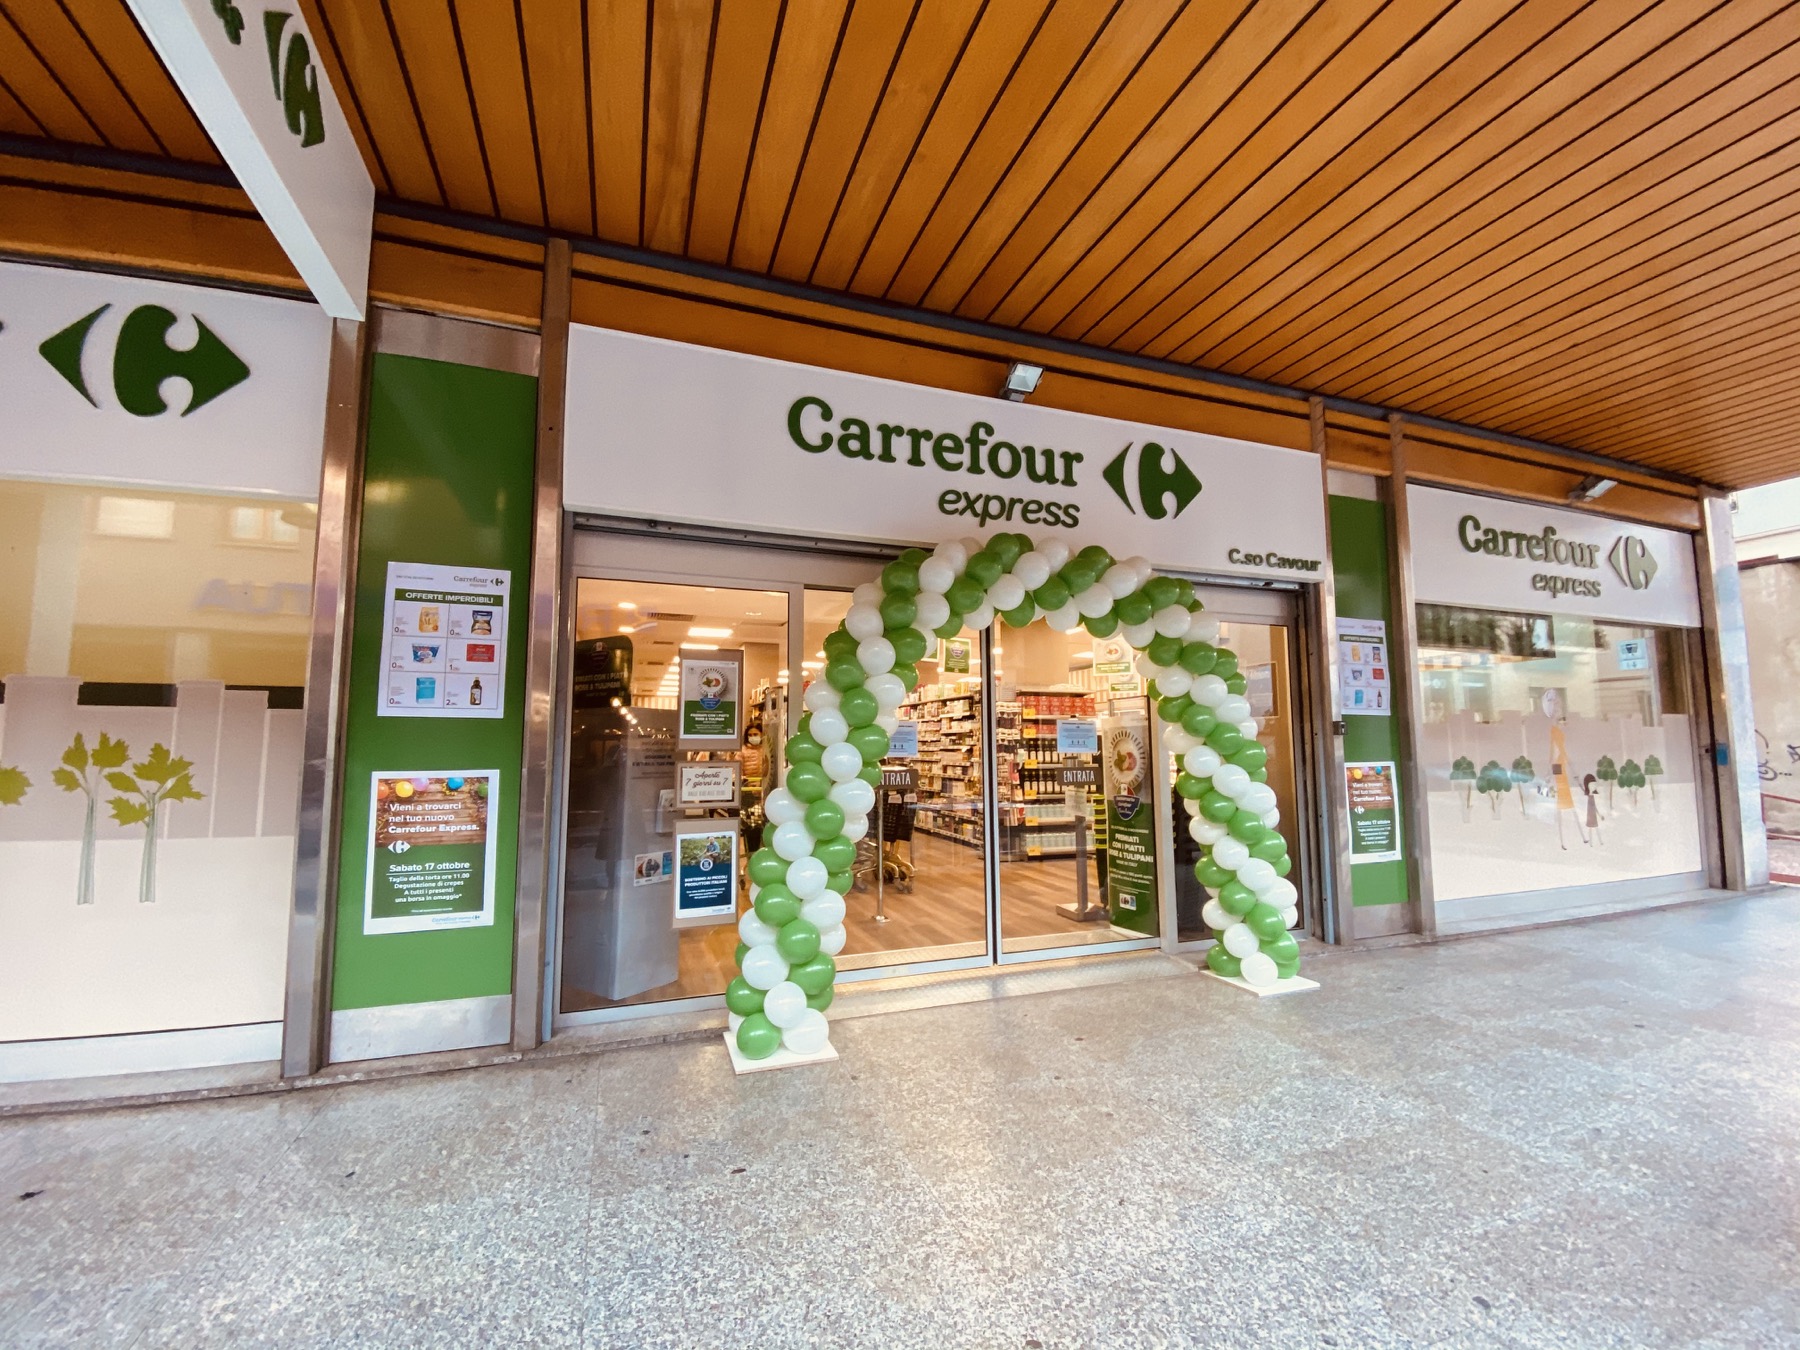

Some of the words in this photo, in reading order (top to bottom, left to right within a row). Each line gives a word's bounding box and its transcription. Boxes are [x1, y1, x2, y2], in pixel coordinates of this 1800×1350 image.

[787, 396, 1084, 487] Carrefour
[938, 489, 1081, 528] express
[1458, 514, 1601, 569] Carrefour
[1228, 548, 1264, 566] C.so
[1265, 552, 1322, 572] Cavour
[1532, 572, 1601, 598] express
[405, 592, 444, 601] OFFERTE
[445, 595, 494, 604] IMPERDIBILI
[1063, 770, 1095, 782] ENTRATA
[390, 803, 414, 812] Vieni
[425, 802, 462, 811] trovarci
[388, 824, 436, 834] Carrefour
[439, 824, 480, 833] Express.
[1115, 834, 1139, 843] PREMIATI
[1125, 844, 1145, 853] PIATTI
[1123, 853, 1154, 862] TULIPANI
[437, 862, 470, 870] ottobre
